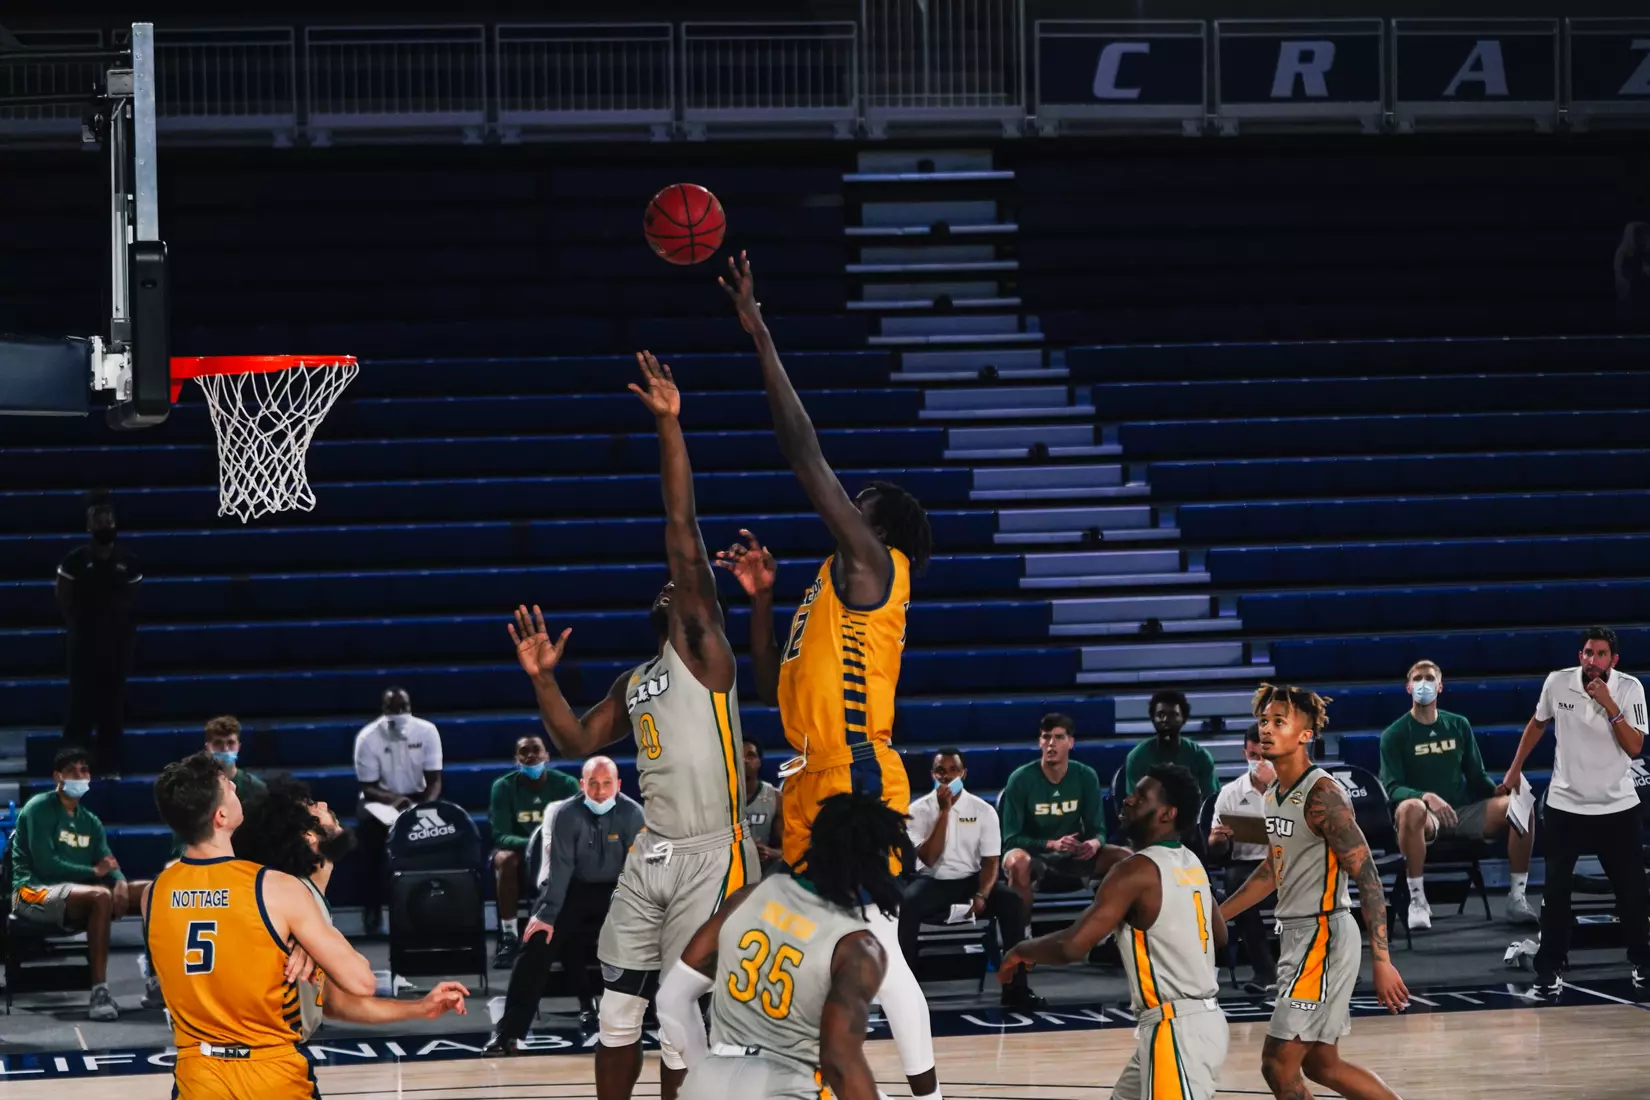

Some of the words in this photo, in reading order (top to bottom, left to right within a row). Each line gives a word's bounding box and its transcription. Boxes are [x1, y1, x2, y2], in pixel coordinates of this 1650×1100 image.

[1093, 42, 1149, 98] C
[1270, 40, 1336, 96] R
[1443, 40, 1510, 96] A
[639, 712, 662, 760] 0
[1414, 739, 1456, 756] SLU
[516, 810, 543, 823] SL
[1034, 799, 1078, 816] SLU
[958, 816, 977, 824] SLU
[1265, 816, 1295, 837] SLU
[59, 829, 91, 849] SLU
[408, 823, 456, 841] adidas
[171, 889, 230, 908] NOTTAGE
[184, 920, 218, 976] 5
[728, 928, 804, 1021] 35
[1290, 1000, 1318, 1012] SLU
